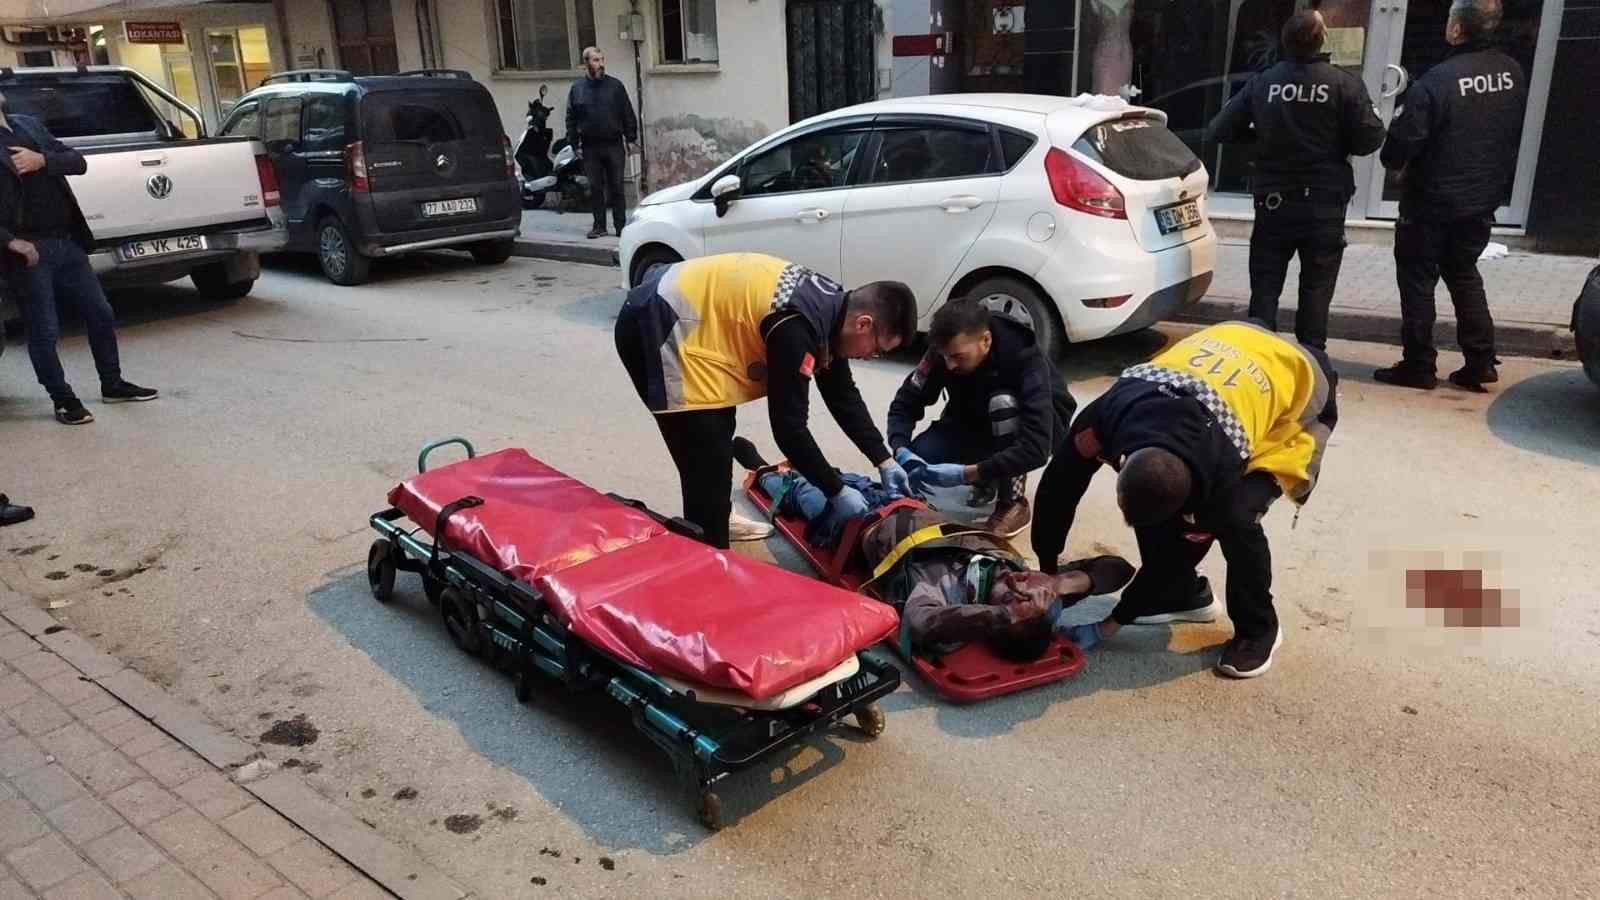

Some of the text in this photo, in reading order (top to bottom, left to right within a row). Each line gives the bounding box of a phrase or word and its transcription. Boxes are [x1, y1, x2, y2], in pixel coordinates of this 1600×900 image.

[130, 236, 199, 257] 16 VK 425
[1188, 348, 1241, 387] 112
